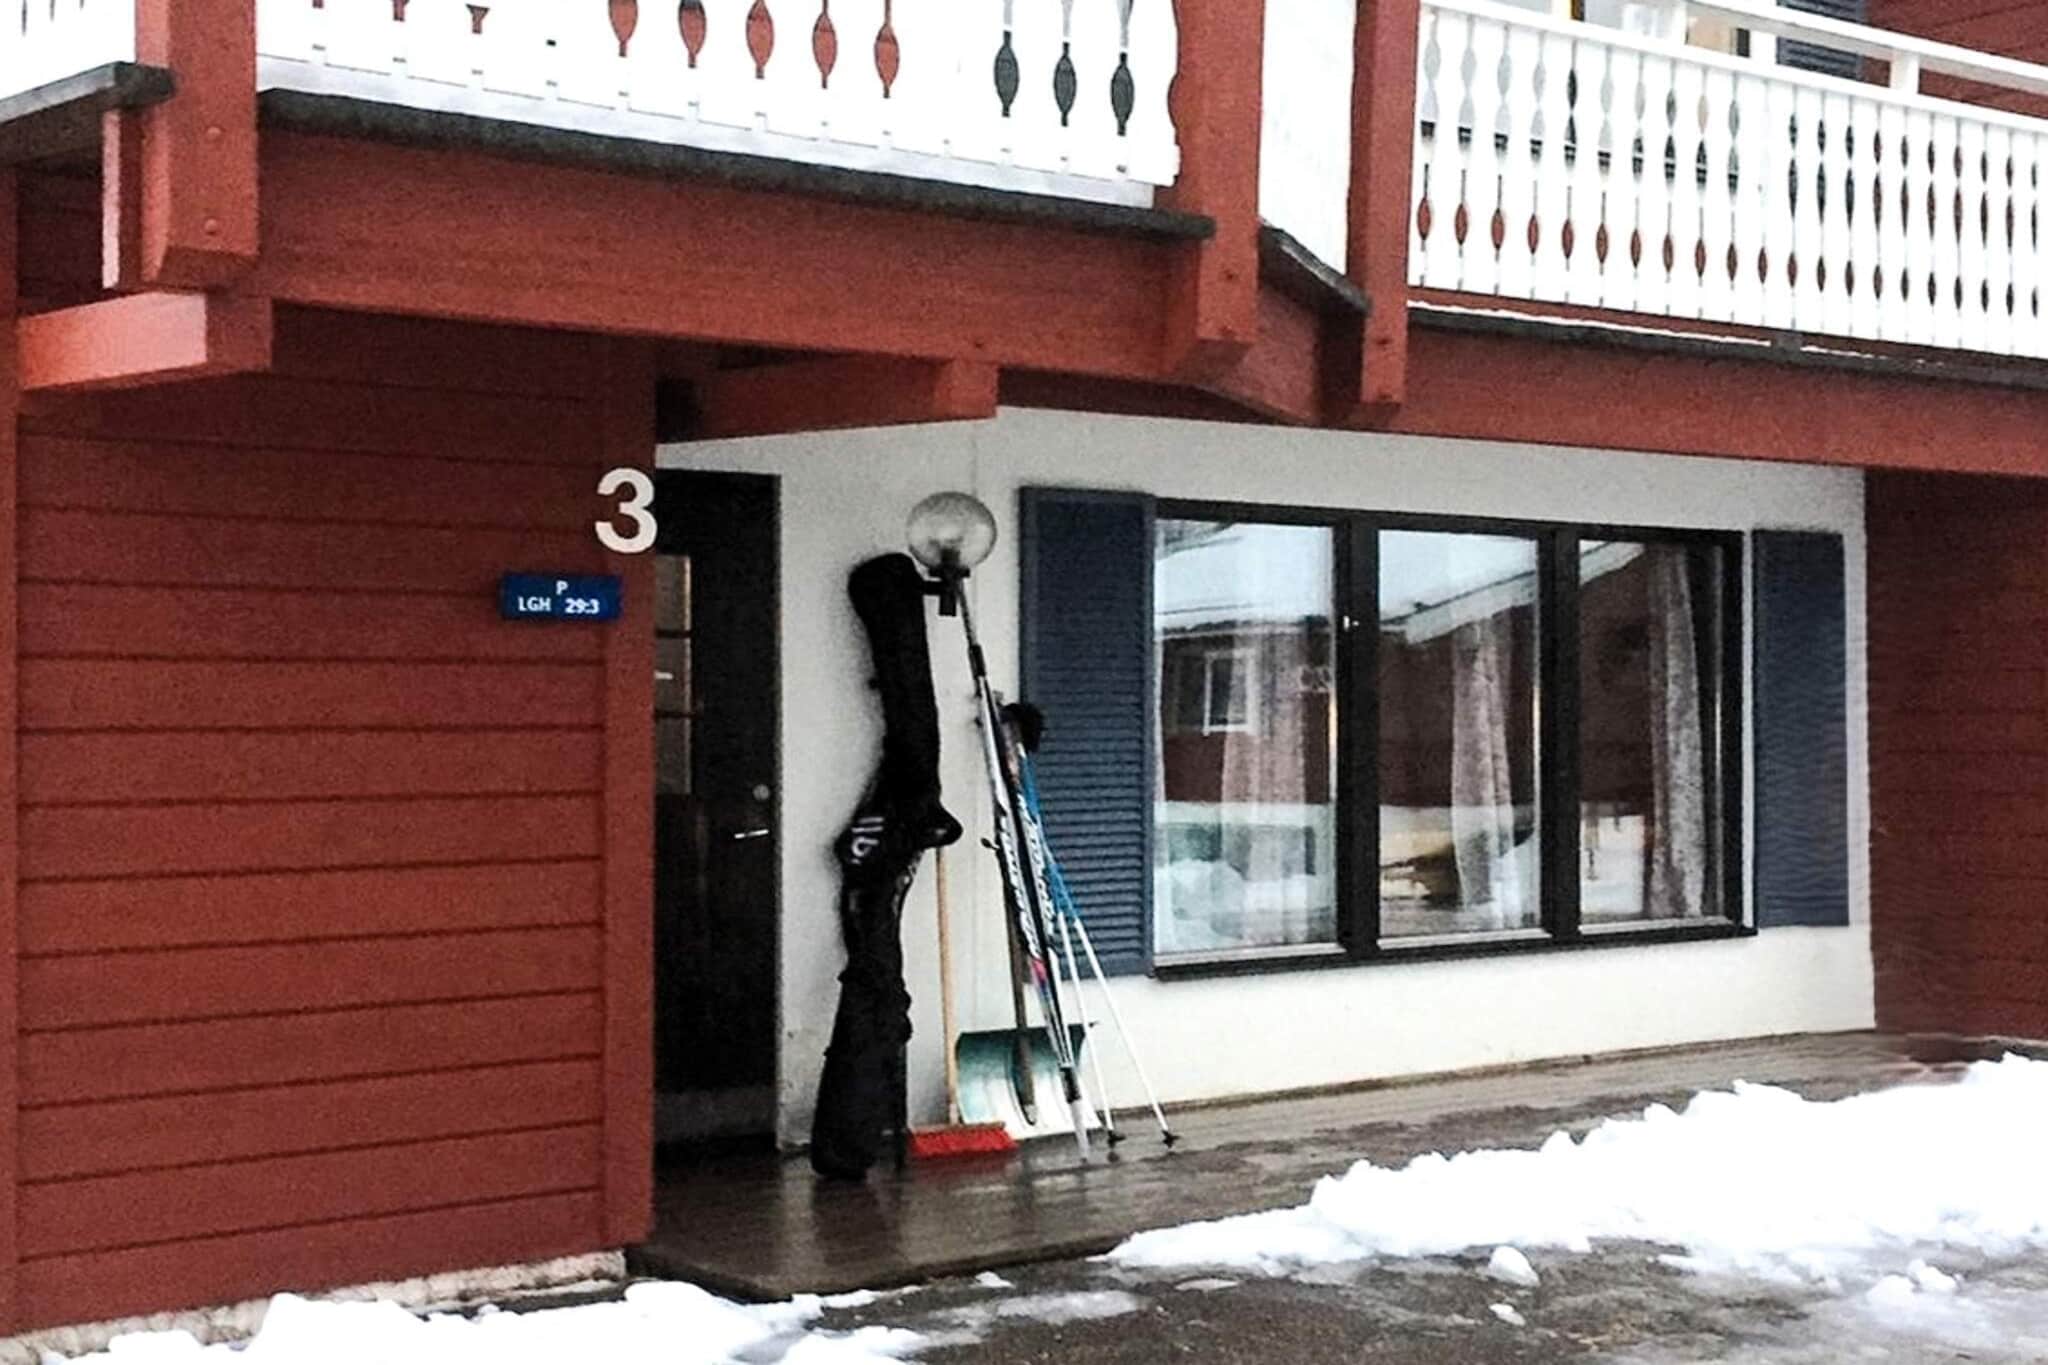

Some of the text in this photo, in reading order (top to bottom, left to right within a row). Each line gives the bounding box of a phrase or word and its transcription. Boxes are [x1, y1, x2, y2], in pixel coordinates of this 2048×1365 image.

[595, 467, 657, 554] 3
[556, 580, 569, 596] P
[518, 596, 552, 612] LGH
